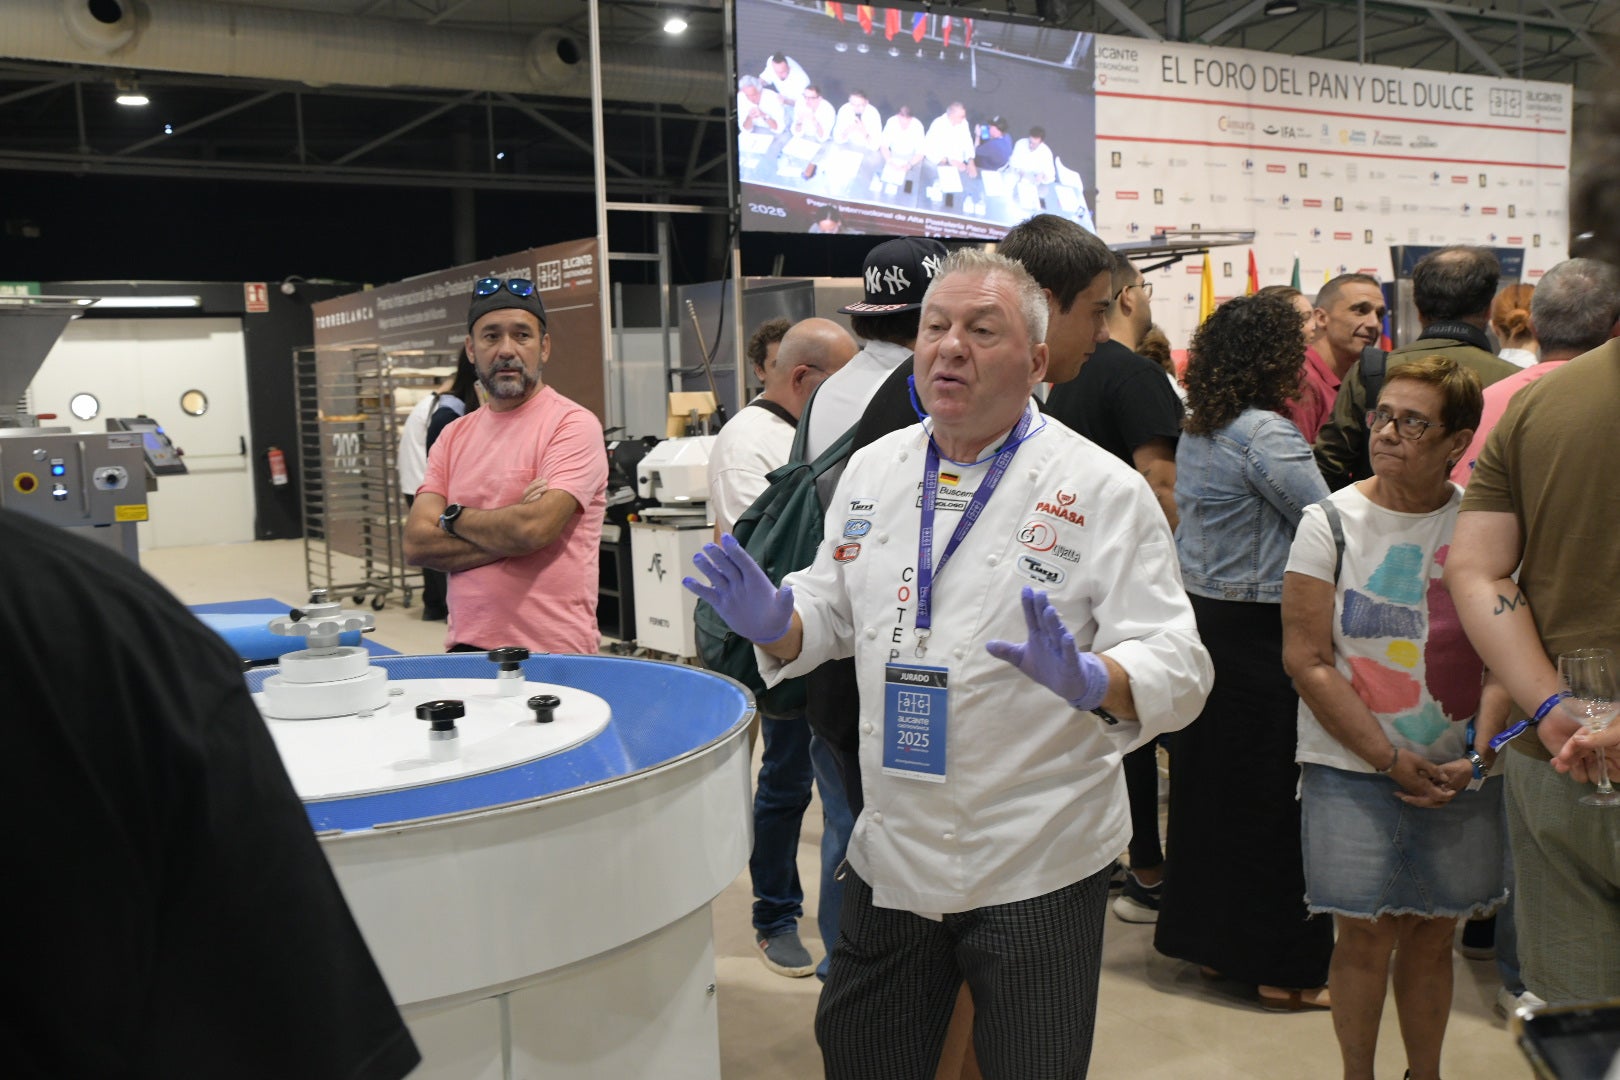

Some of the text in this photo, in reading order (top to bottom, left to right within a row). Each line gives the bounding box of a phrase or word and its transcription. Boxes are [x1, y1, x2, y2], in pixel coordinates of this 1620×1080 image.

[1161, 55, 1474, 112] EL FORO DEL PAN Y DEL DULCE
[748, 202, 787, 218] 2025
[315, 307, 374, 329] TORREBLANCA
[939, 486, 975, 499] Buscem
[1035, 502, 1085, 528] PANASA
[900, 672, 930, 683] JURADO
[897, 730, 930, 748] 2025
